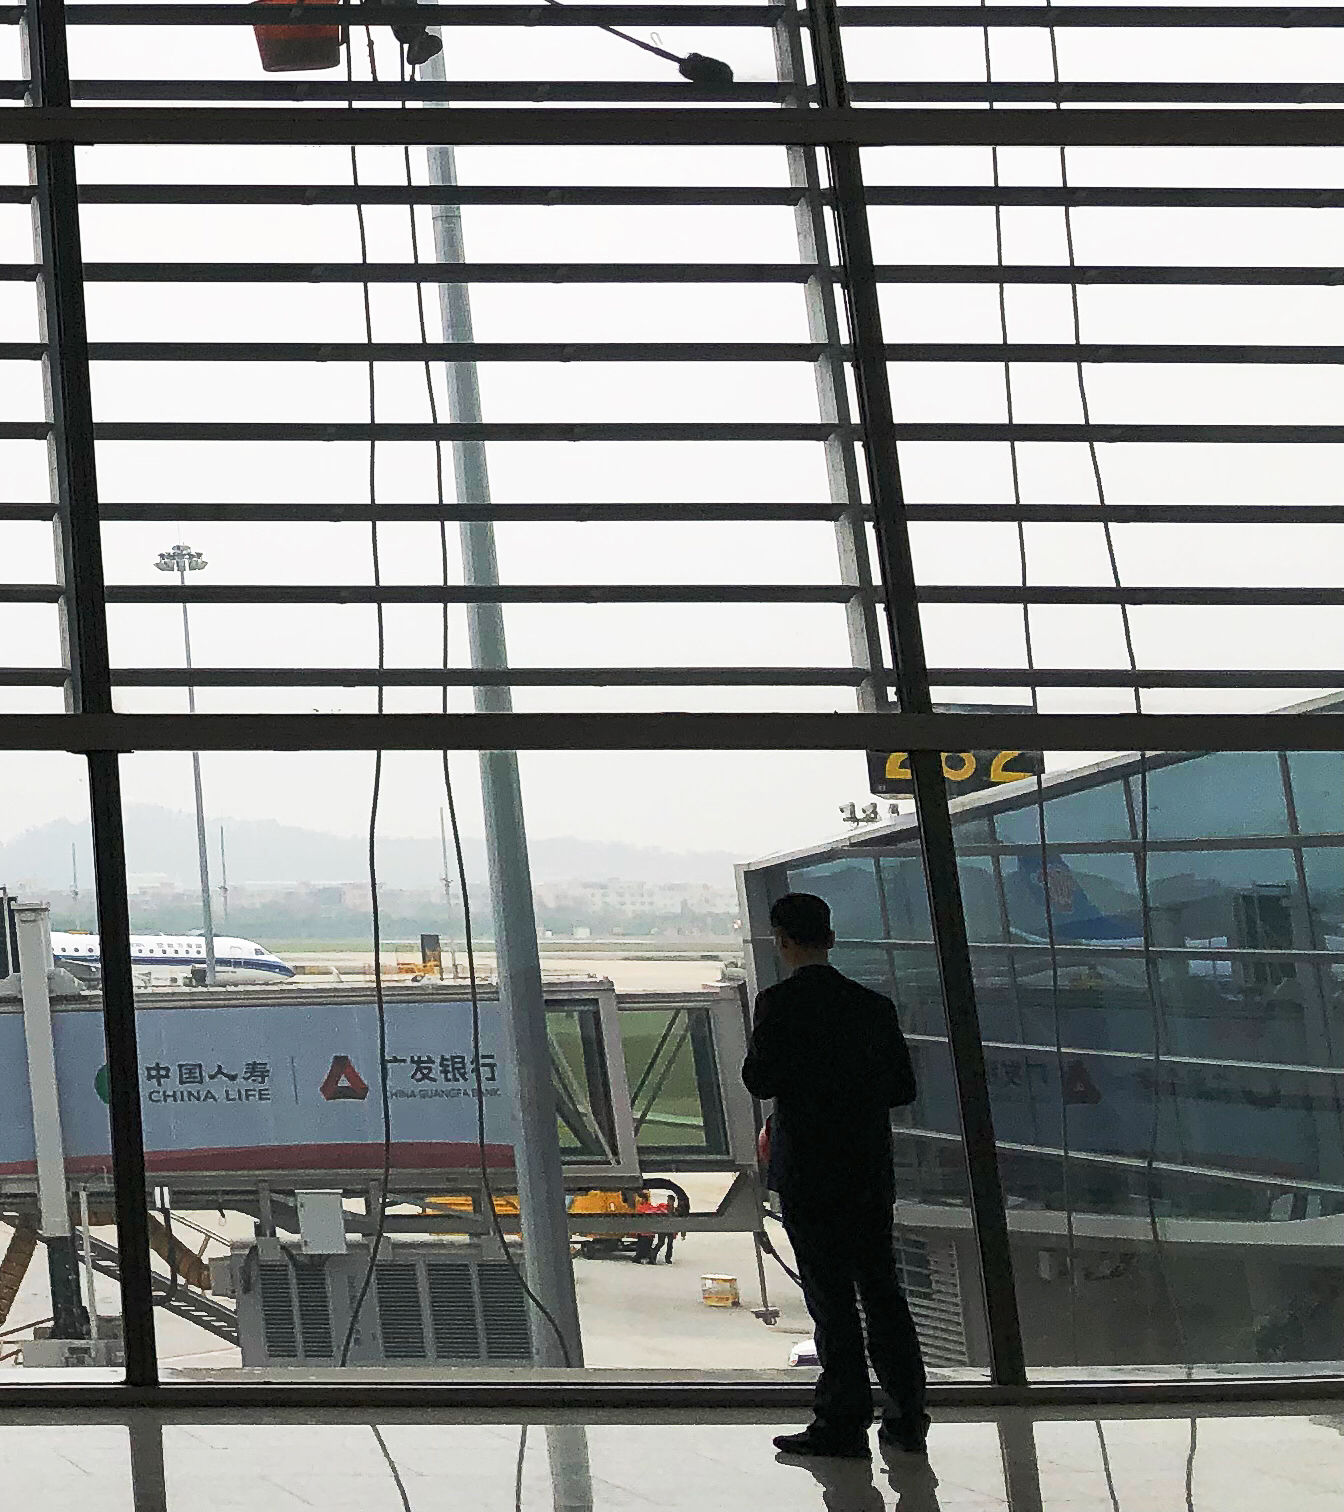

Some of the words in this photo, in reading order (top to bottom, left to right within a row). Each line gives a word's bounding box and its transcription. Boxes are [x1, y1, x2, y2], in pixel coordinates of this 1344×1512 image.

[145, 1060, 271, 1087] 中国人寿
[147, 1089, 217, 1104] CHINA
[224, 1088, 271, 1102] LIFE
[385, 1089, 416, 1098] HINA
[471, 1088, 501, 1097] BNK
